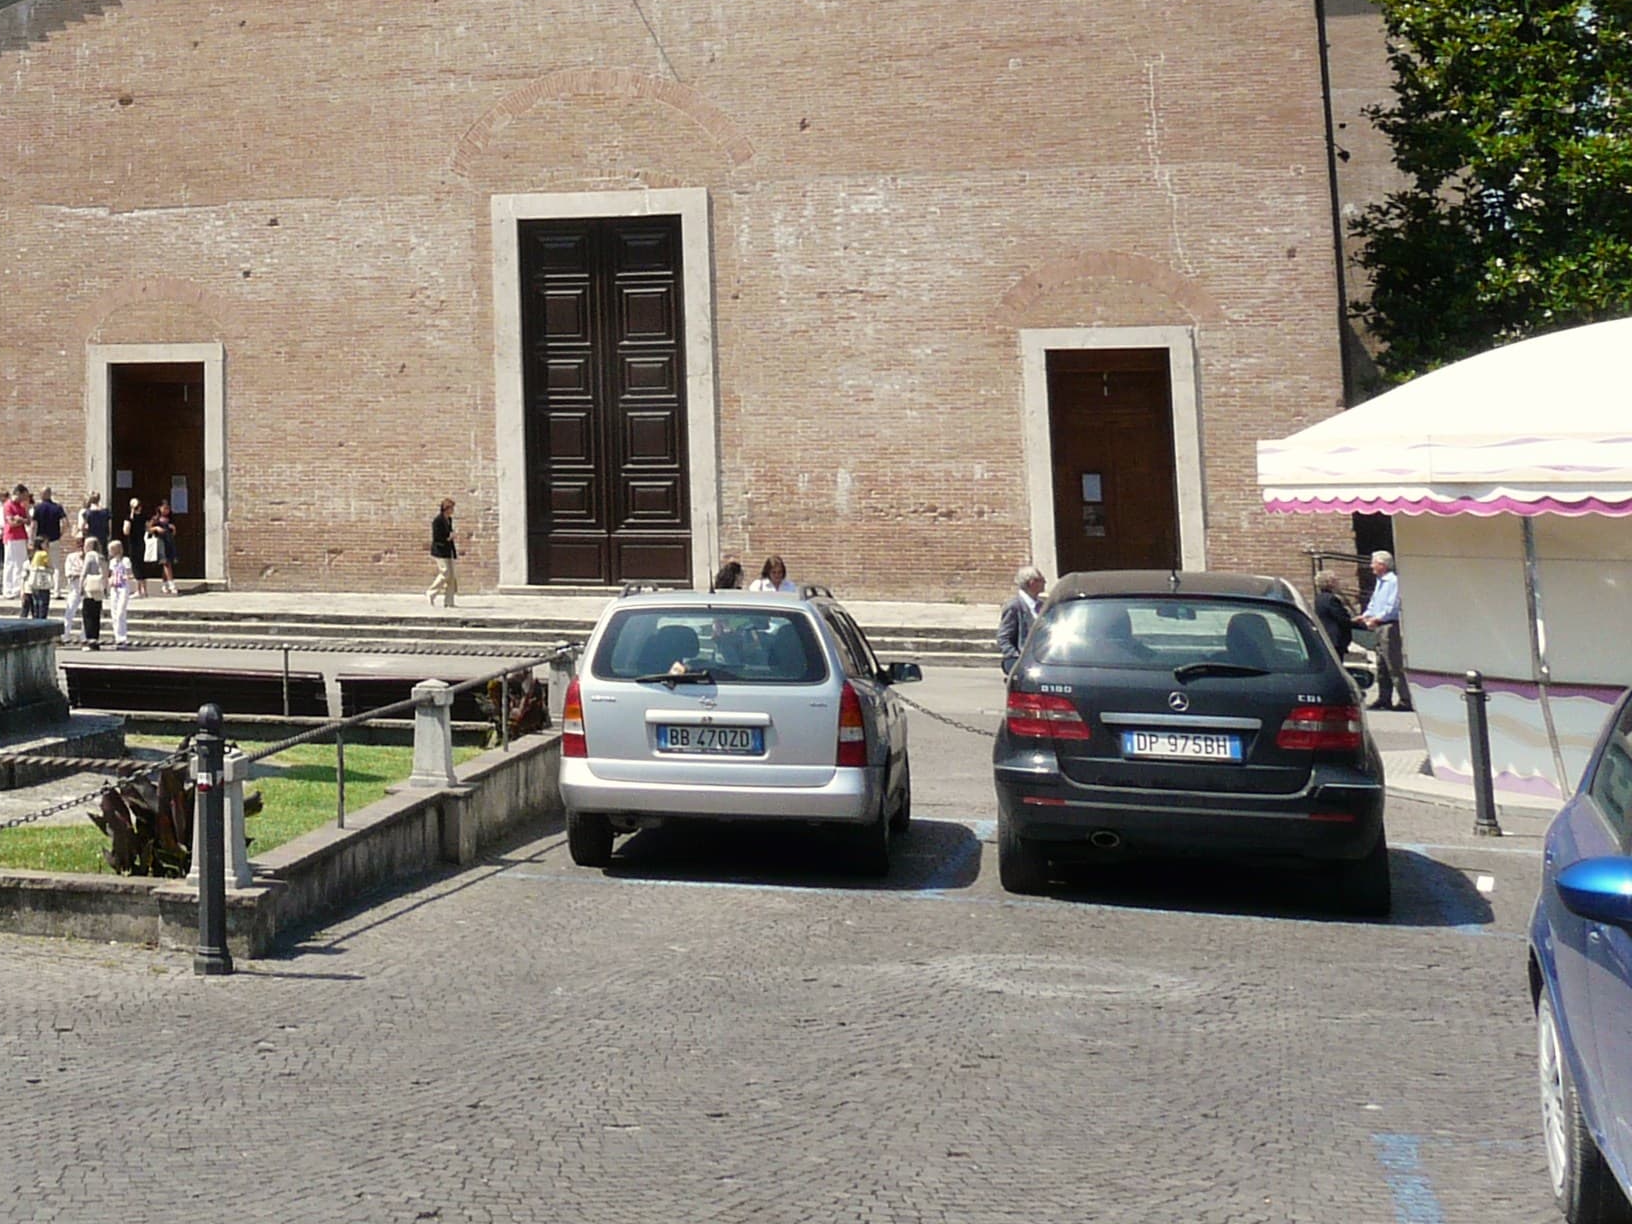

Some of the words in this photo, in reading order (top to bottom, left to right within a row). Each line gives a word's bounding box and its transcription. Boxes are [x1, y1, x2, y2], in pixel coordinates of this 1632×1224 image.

[670, 729, 690, 747] BB
[696, 729, 750, 748] 470ZD
[1136, 733, 1159, 752] DP
[1169, 735, 1228, 756] 975BH
